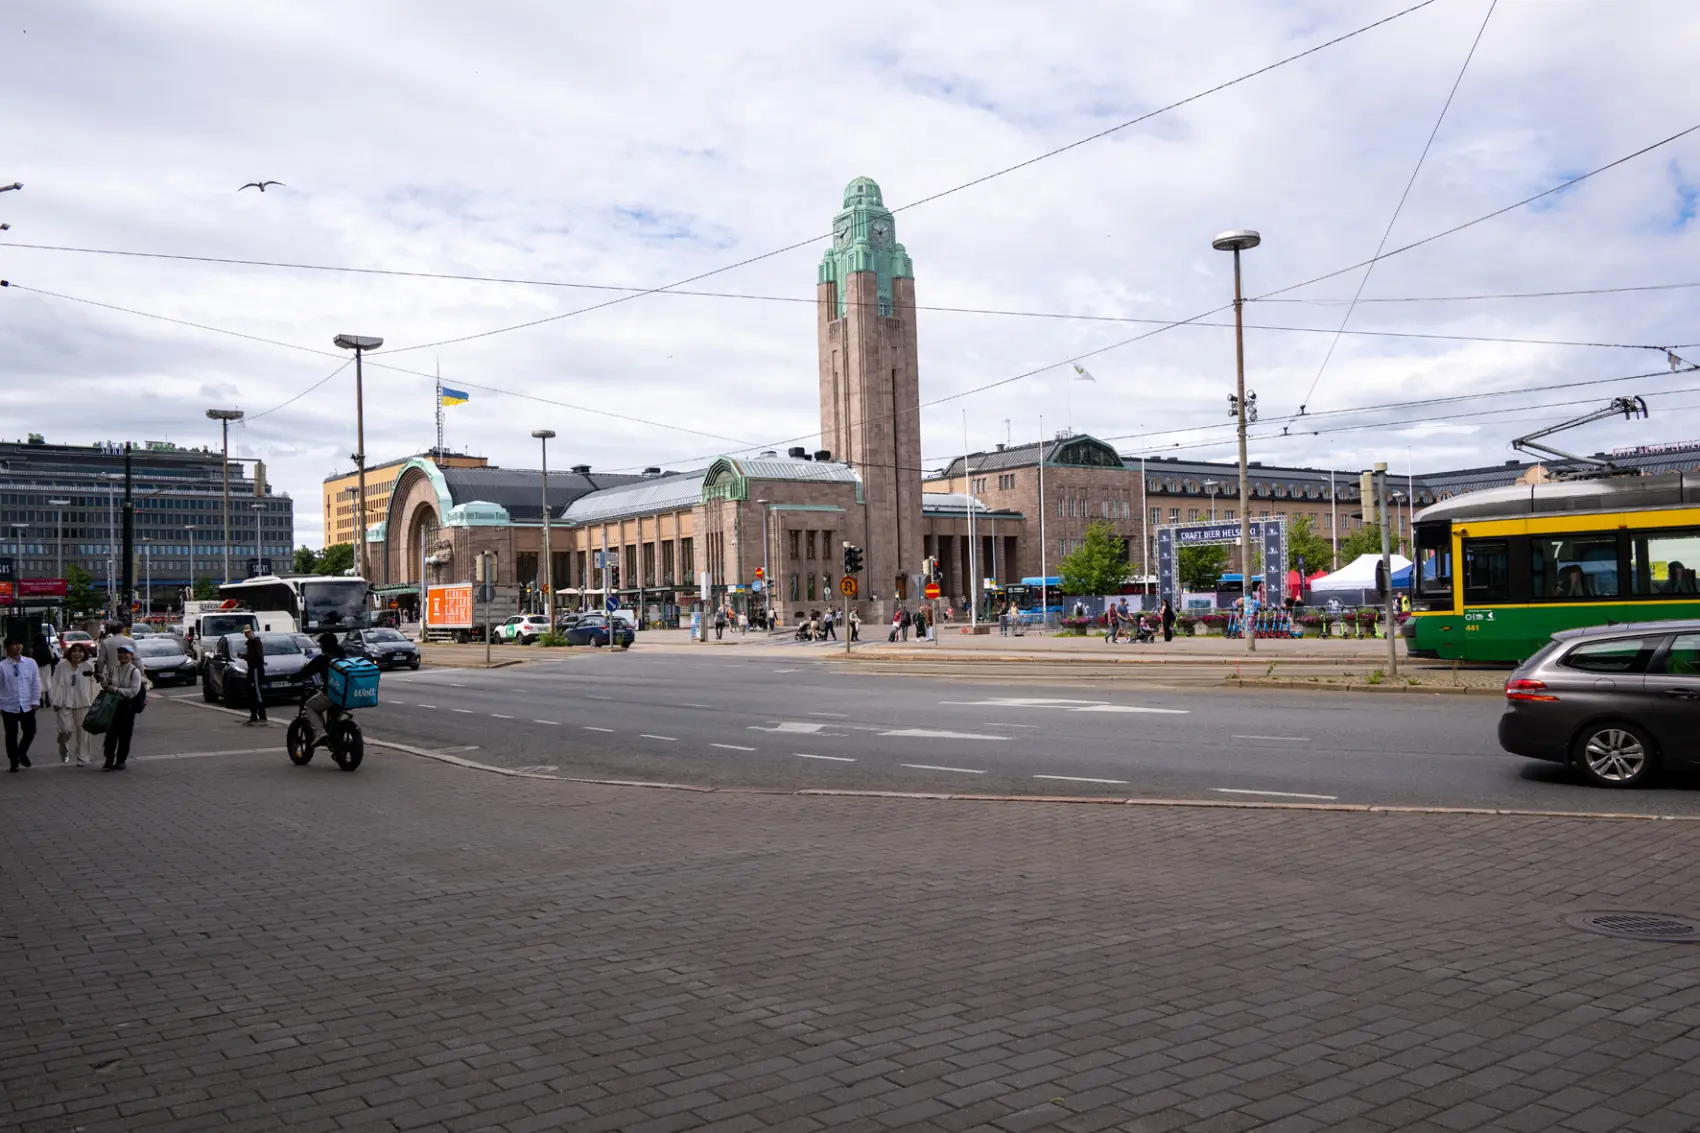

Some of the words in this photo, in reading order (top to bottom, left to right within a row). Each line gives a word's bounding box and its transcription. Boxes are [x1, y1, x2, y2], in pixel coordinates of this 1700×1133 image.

[1180, 531, 1202, 540] CRAFT
[1203, 529, 1220, 539] BEER
[1551, 541, 1563, 559] 7
[1465, 624, 1480, 632] 441
[353, 687, 376, 697] Wolt
